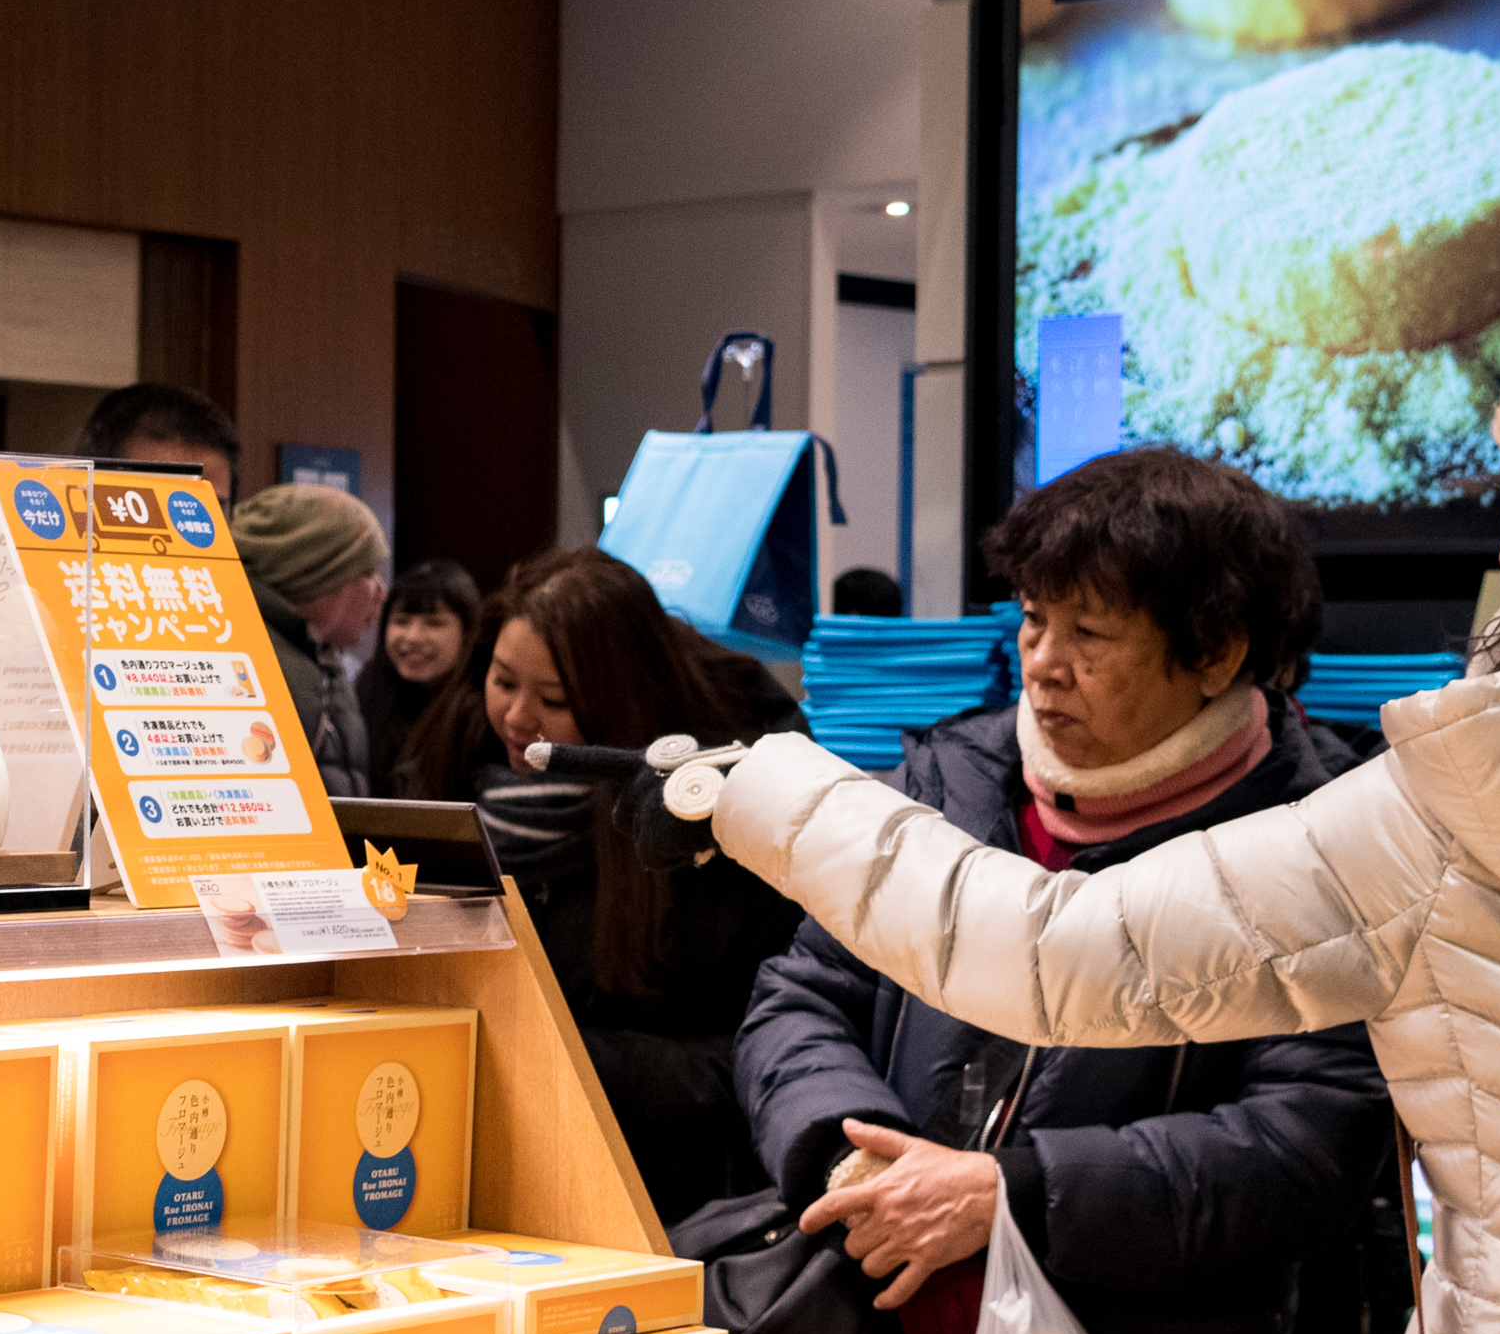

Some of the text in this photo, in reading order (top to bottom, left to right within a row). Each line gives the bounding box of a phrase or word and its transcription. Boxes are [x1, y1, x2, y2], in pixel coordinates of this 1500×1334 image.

[107, 490, 149, 524] ¥0
[22, 509, 60, 527] 今だけ
[58, 560, 223, 614] 送料無料
[76, 609, 232, 644] キャンペーン
[371, 1167, 400, 1179] OTARU
[362, 1177, 407, 1190] Rue IRONAI
[173, 1190, 205, 1203] OTARU
[364, 1188, 405, 1201] FROMAGE
[163, 1200, 214, 1215] Rue IRONAI
[165, 1212, 211, 1226] FROMAGE
